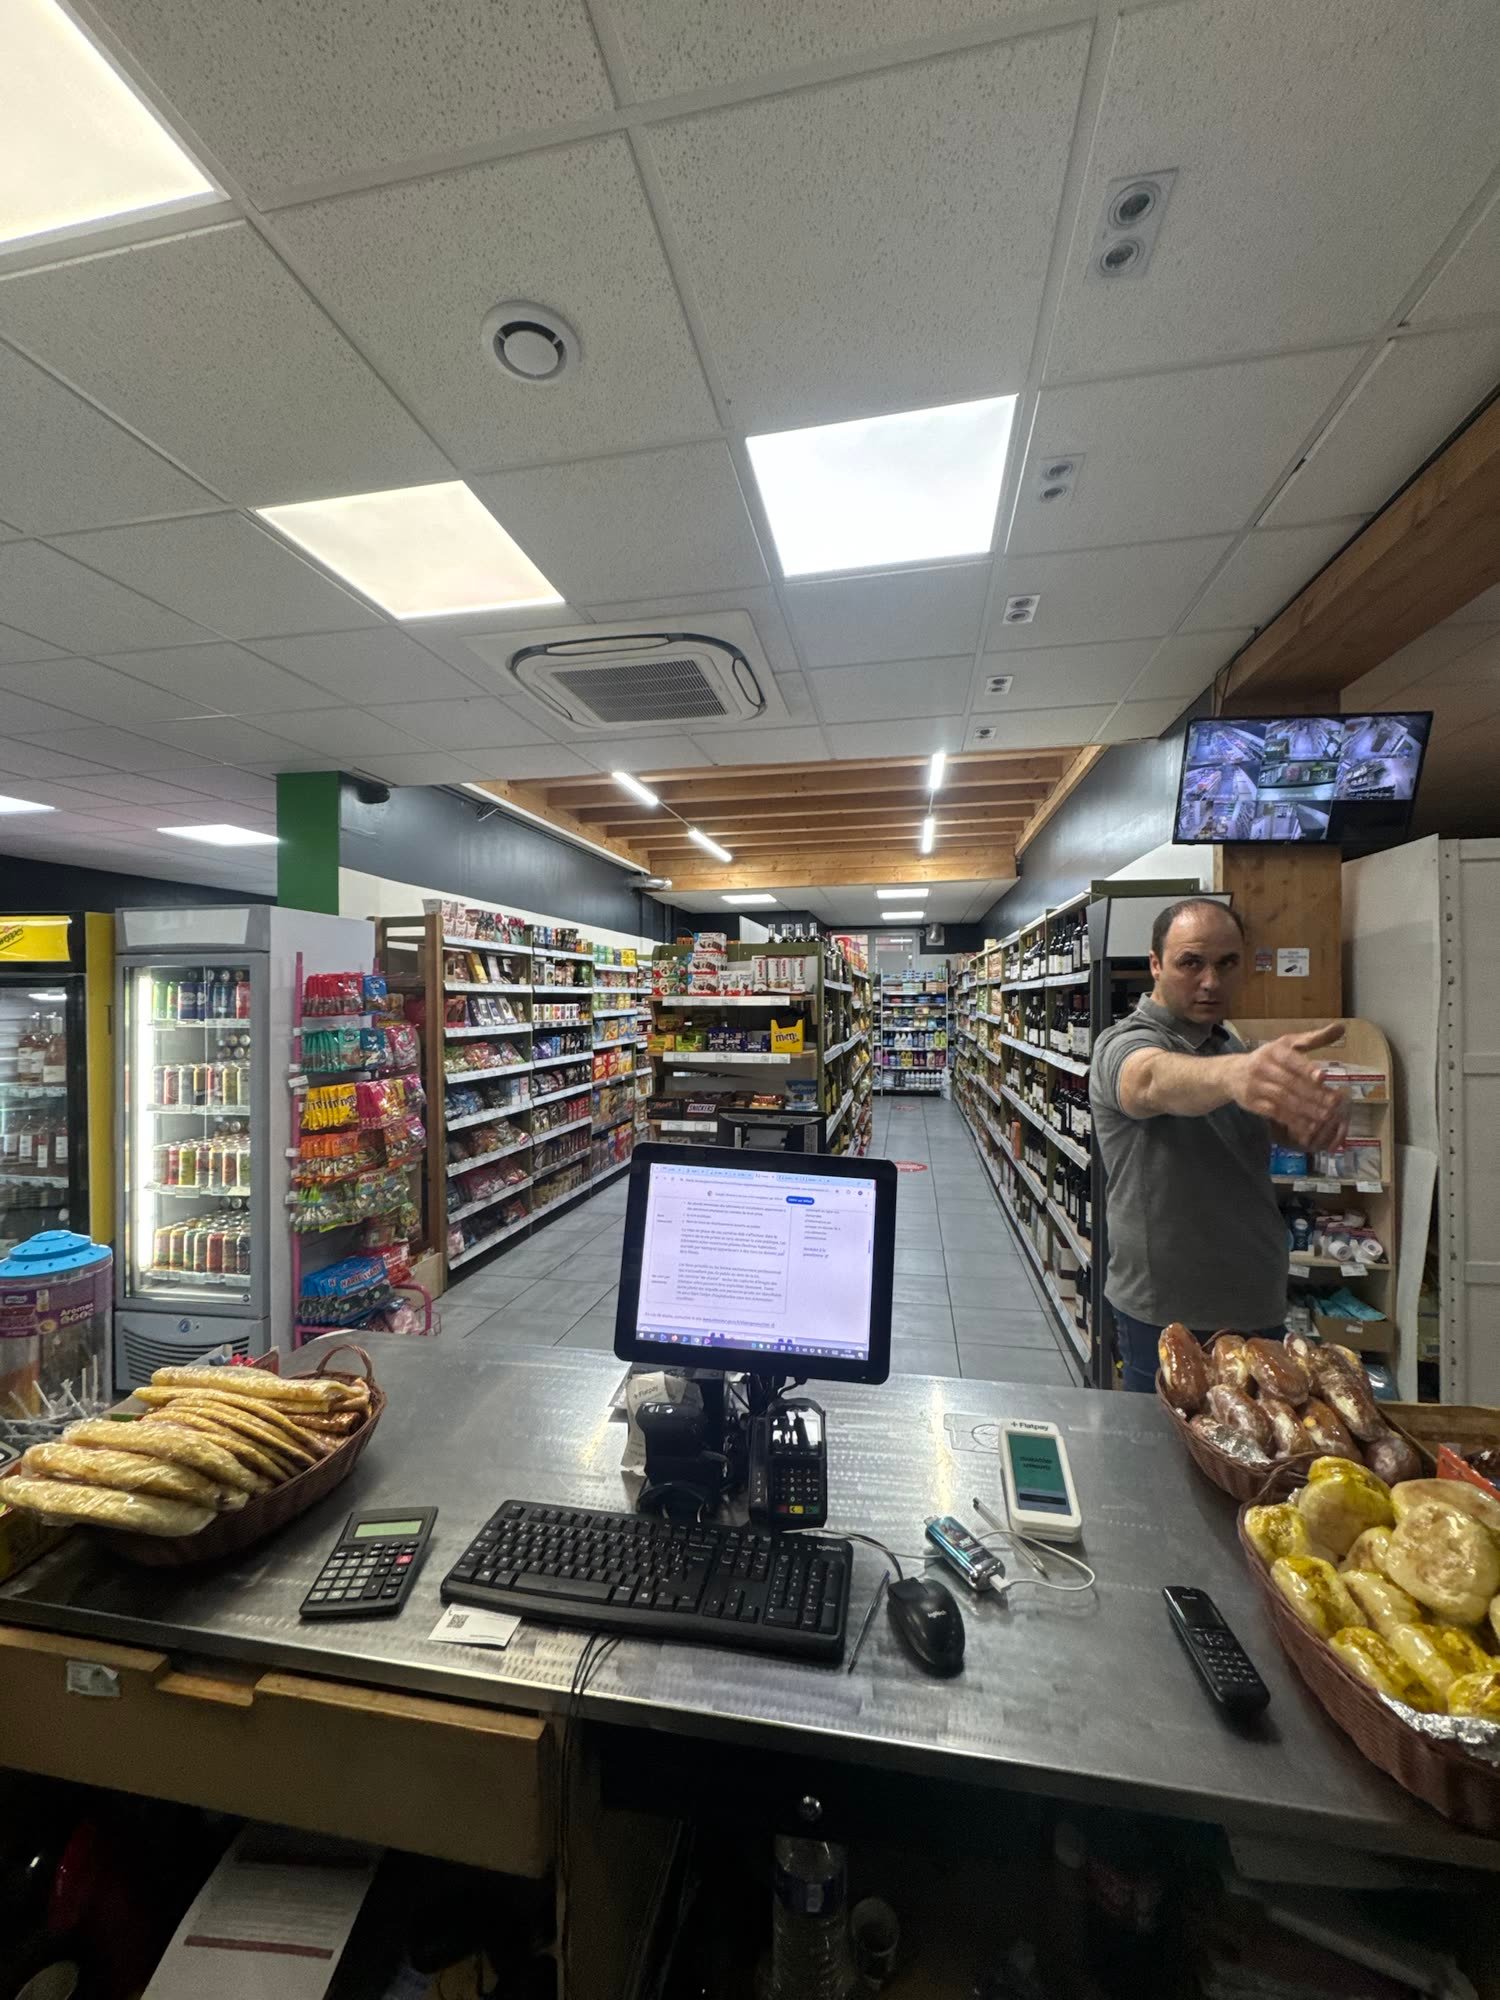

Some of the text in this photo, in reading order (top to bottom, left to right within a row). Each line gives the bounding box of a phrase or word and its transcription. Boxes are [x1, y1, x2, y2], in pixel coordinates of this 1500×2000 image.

[688, 1104, 715, 1112] SNICKERS
[1020, 1422, 1049, 1432] Flatpay
[816, 1544, 842, 1552] logitech
